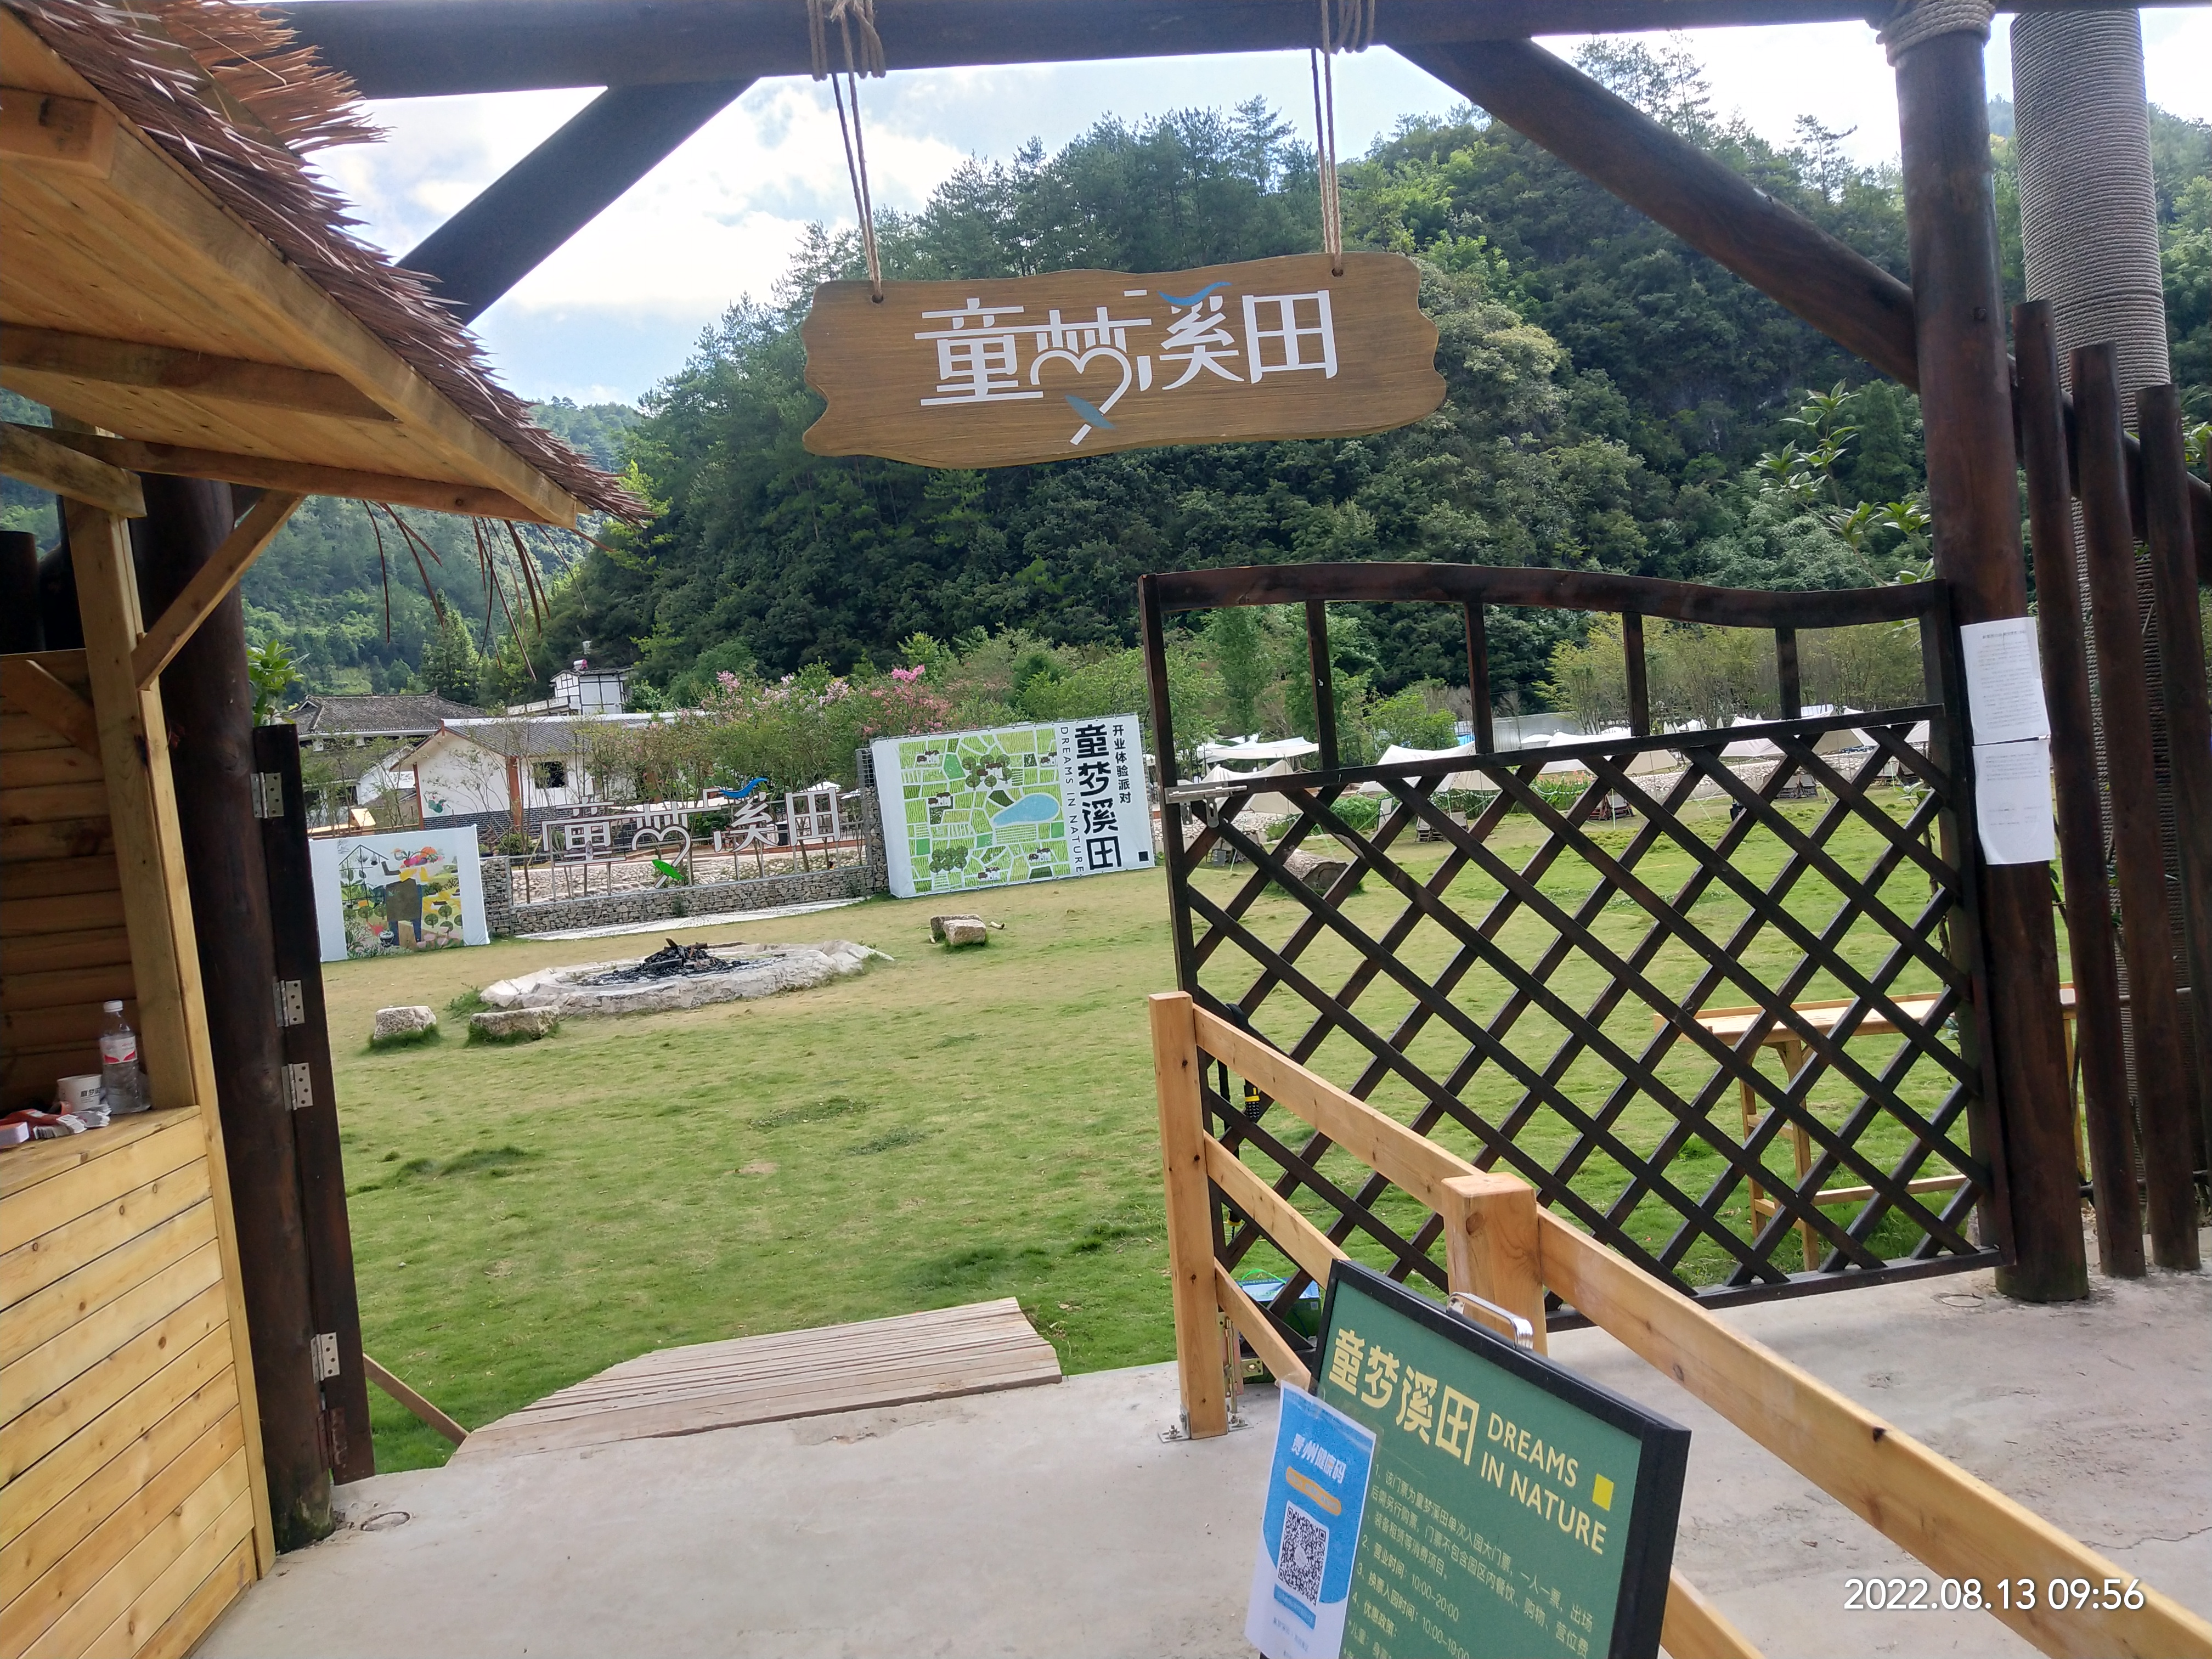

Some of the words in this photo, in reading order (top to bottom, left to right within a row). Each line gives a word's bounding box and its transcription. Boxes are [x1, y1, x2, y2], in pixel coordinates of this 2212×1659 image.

[915, 281, 1338, 446] 童梦溪田
[1060, 726, 1074, 785] DREAMS
[1111, 724, 1132, 804] 开业体验派对
[541, 777, 842, 890] 童梦溪田
[1066, 792, 1076, 807] IN
[1074, 724, 1122, 871] 童梦溪田
[1069, 815, 1085, 873] NATURE
[1329, 1328, 1480, 1465] 童梦溪田
[1291, 1433, 1347, 1484] 贵州健康码
[1487, 1412, 1579, 1487] DREAMS
[1481, 1451, 1505, 1489] IN
[1510, 1469, 1607, 1555] NATURE
